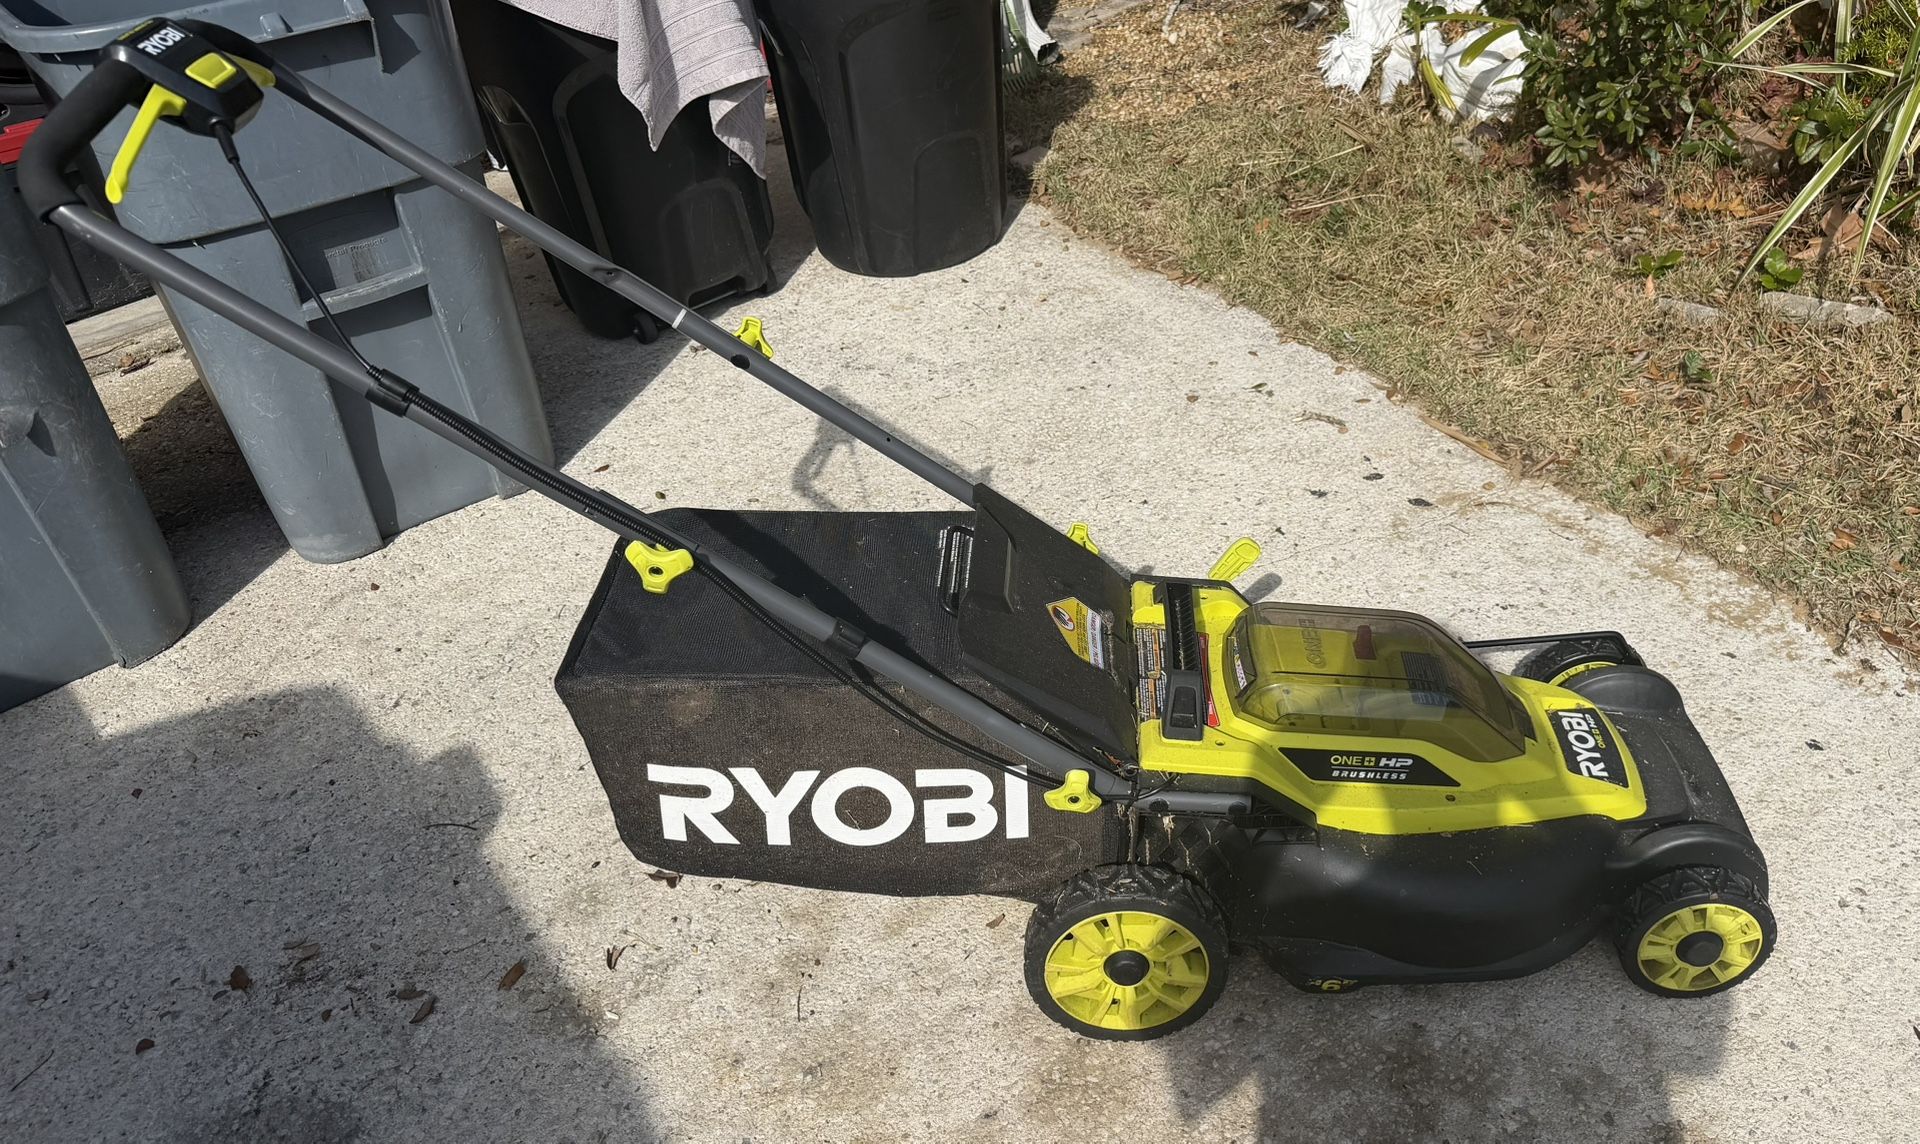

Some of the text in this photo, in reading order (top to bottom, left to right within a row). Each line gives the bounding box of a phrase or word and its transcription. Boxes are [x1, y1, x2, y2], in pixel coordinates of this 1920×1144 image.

[136, 26, 186, 56] RYOBI
[1584, 713, 1598, 729] HP
[1558, 711, 1610, 777] RYOBI
[1379, 757, 1414, 768] HP
[1332, 769, 1408, 780] BRUSHLESS
[647, 763, 1030, 847] RYOBI
